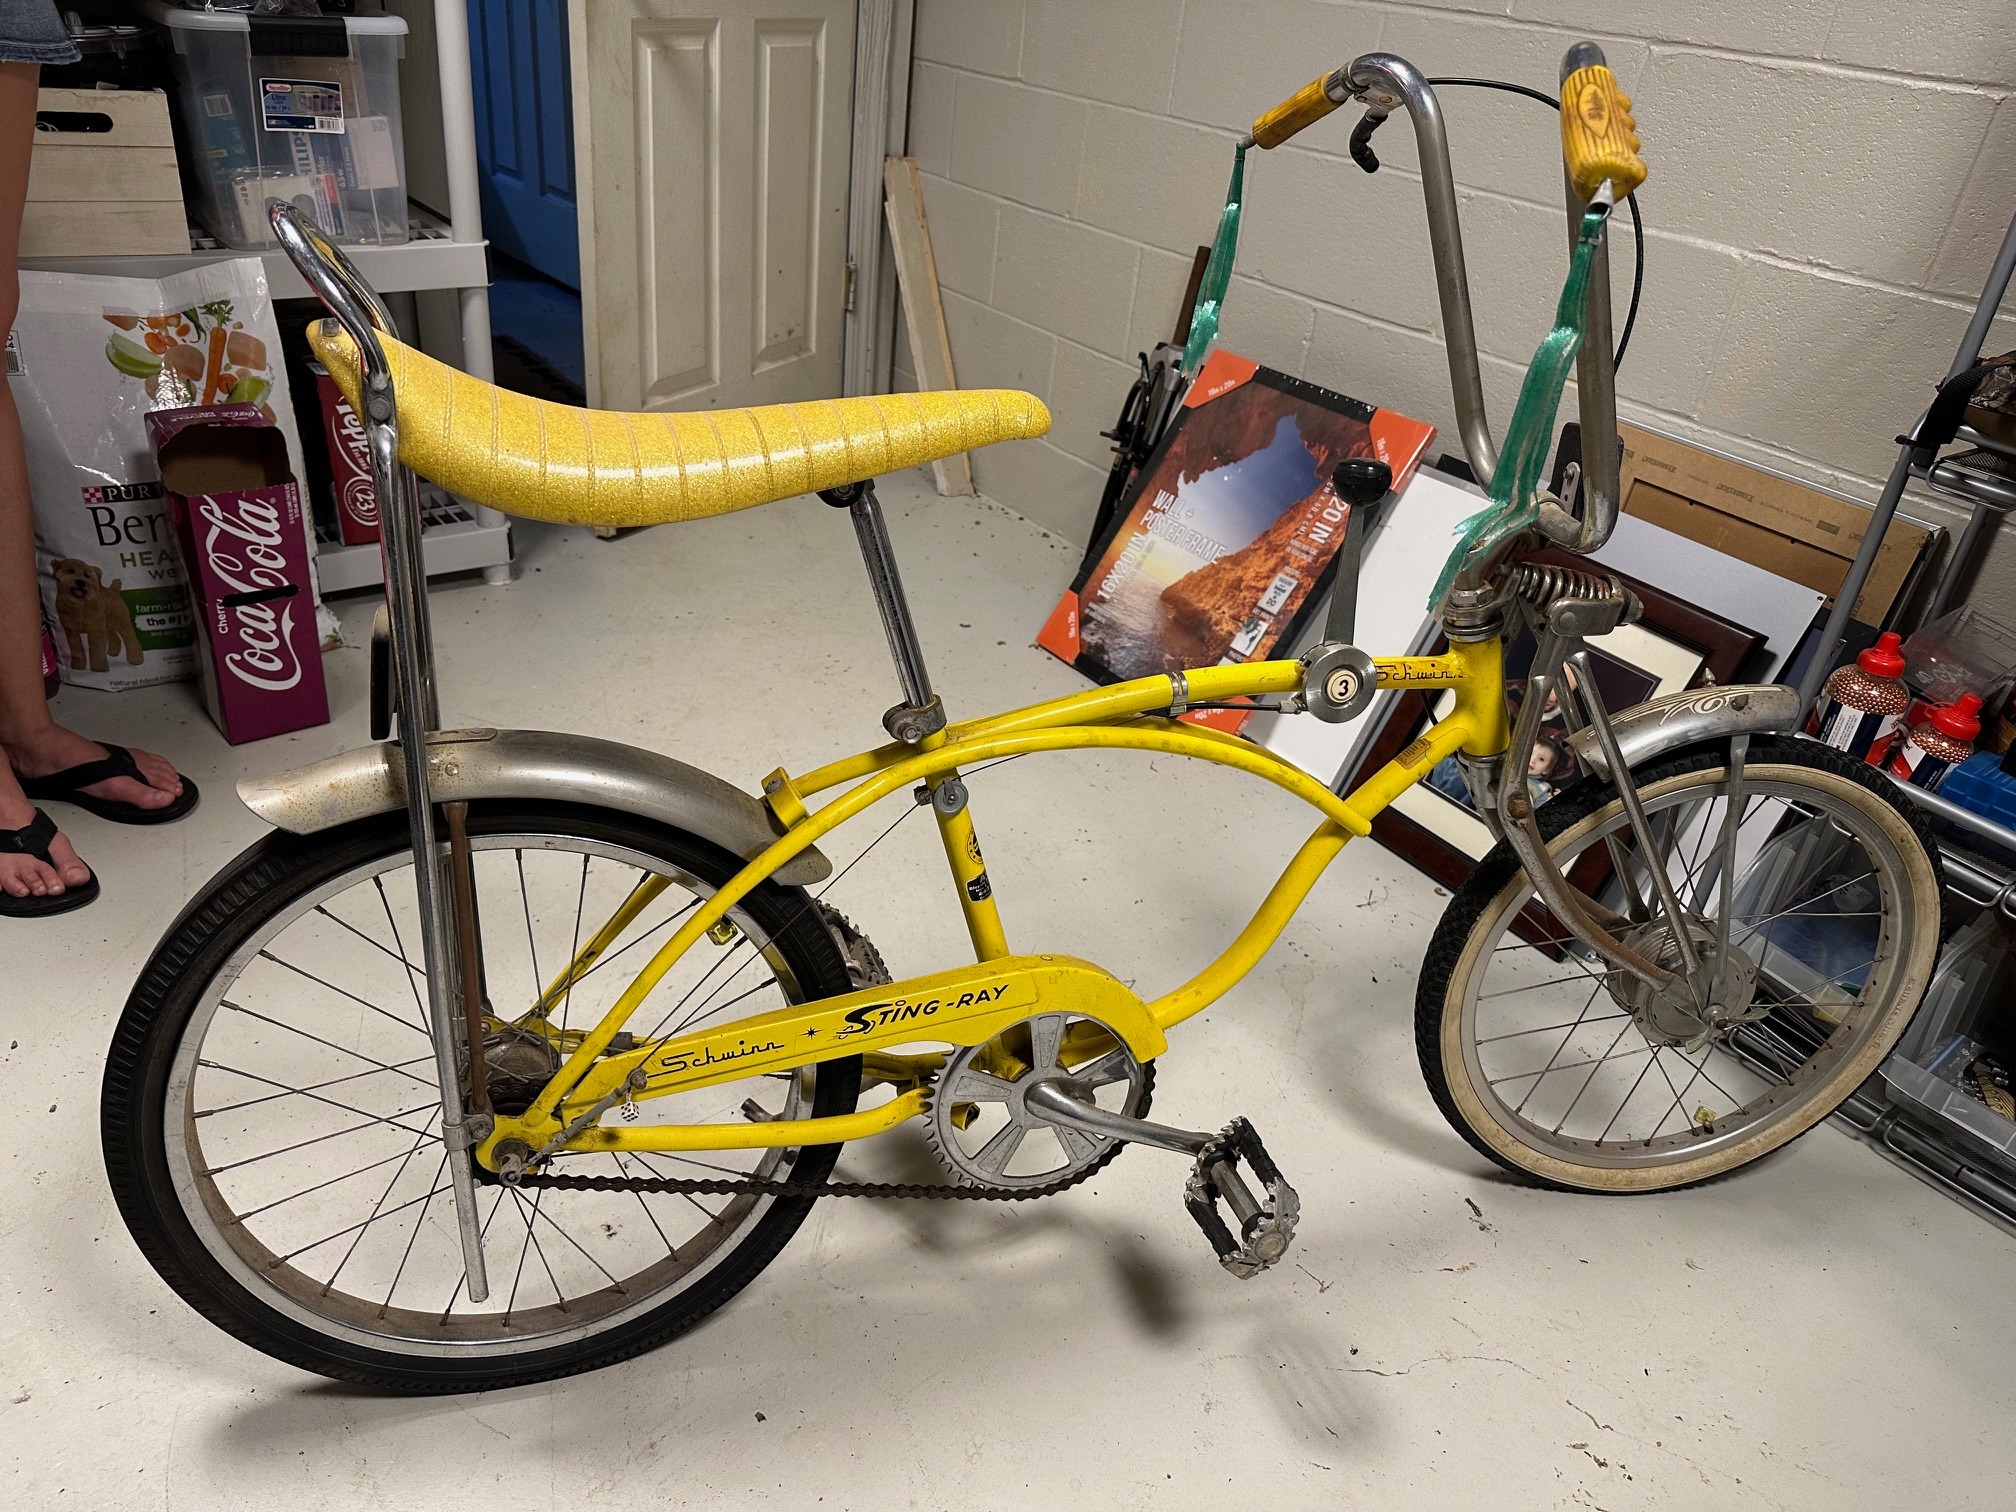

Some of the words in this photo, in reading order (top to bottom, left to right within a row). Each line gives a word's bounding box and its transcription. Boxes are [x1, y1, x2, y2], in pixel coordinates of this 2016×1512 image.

[106, 484, 158, 500] PUR
[355, 491, 376, 511] 23
[1152, 489, 1186, 519] WALL
[1129, 531, 1148, 554] IN
[1139, 509, 1186, 547] POSTER
[1182, 529, 1227, 565] FRAME
[1308, 521, 1333, 544] IN
[120, 548, 174, 568] HEA
[146, 617, 166, 626] the
[1338, 680, 1348, 696] 3
[647, 1040, 785, 1079] Schwinn
